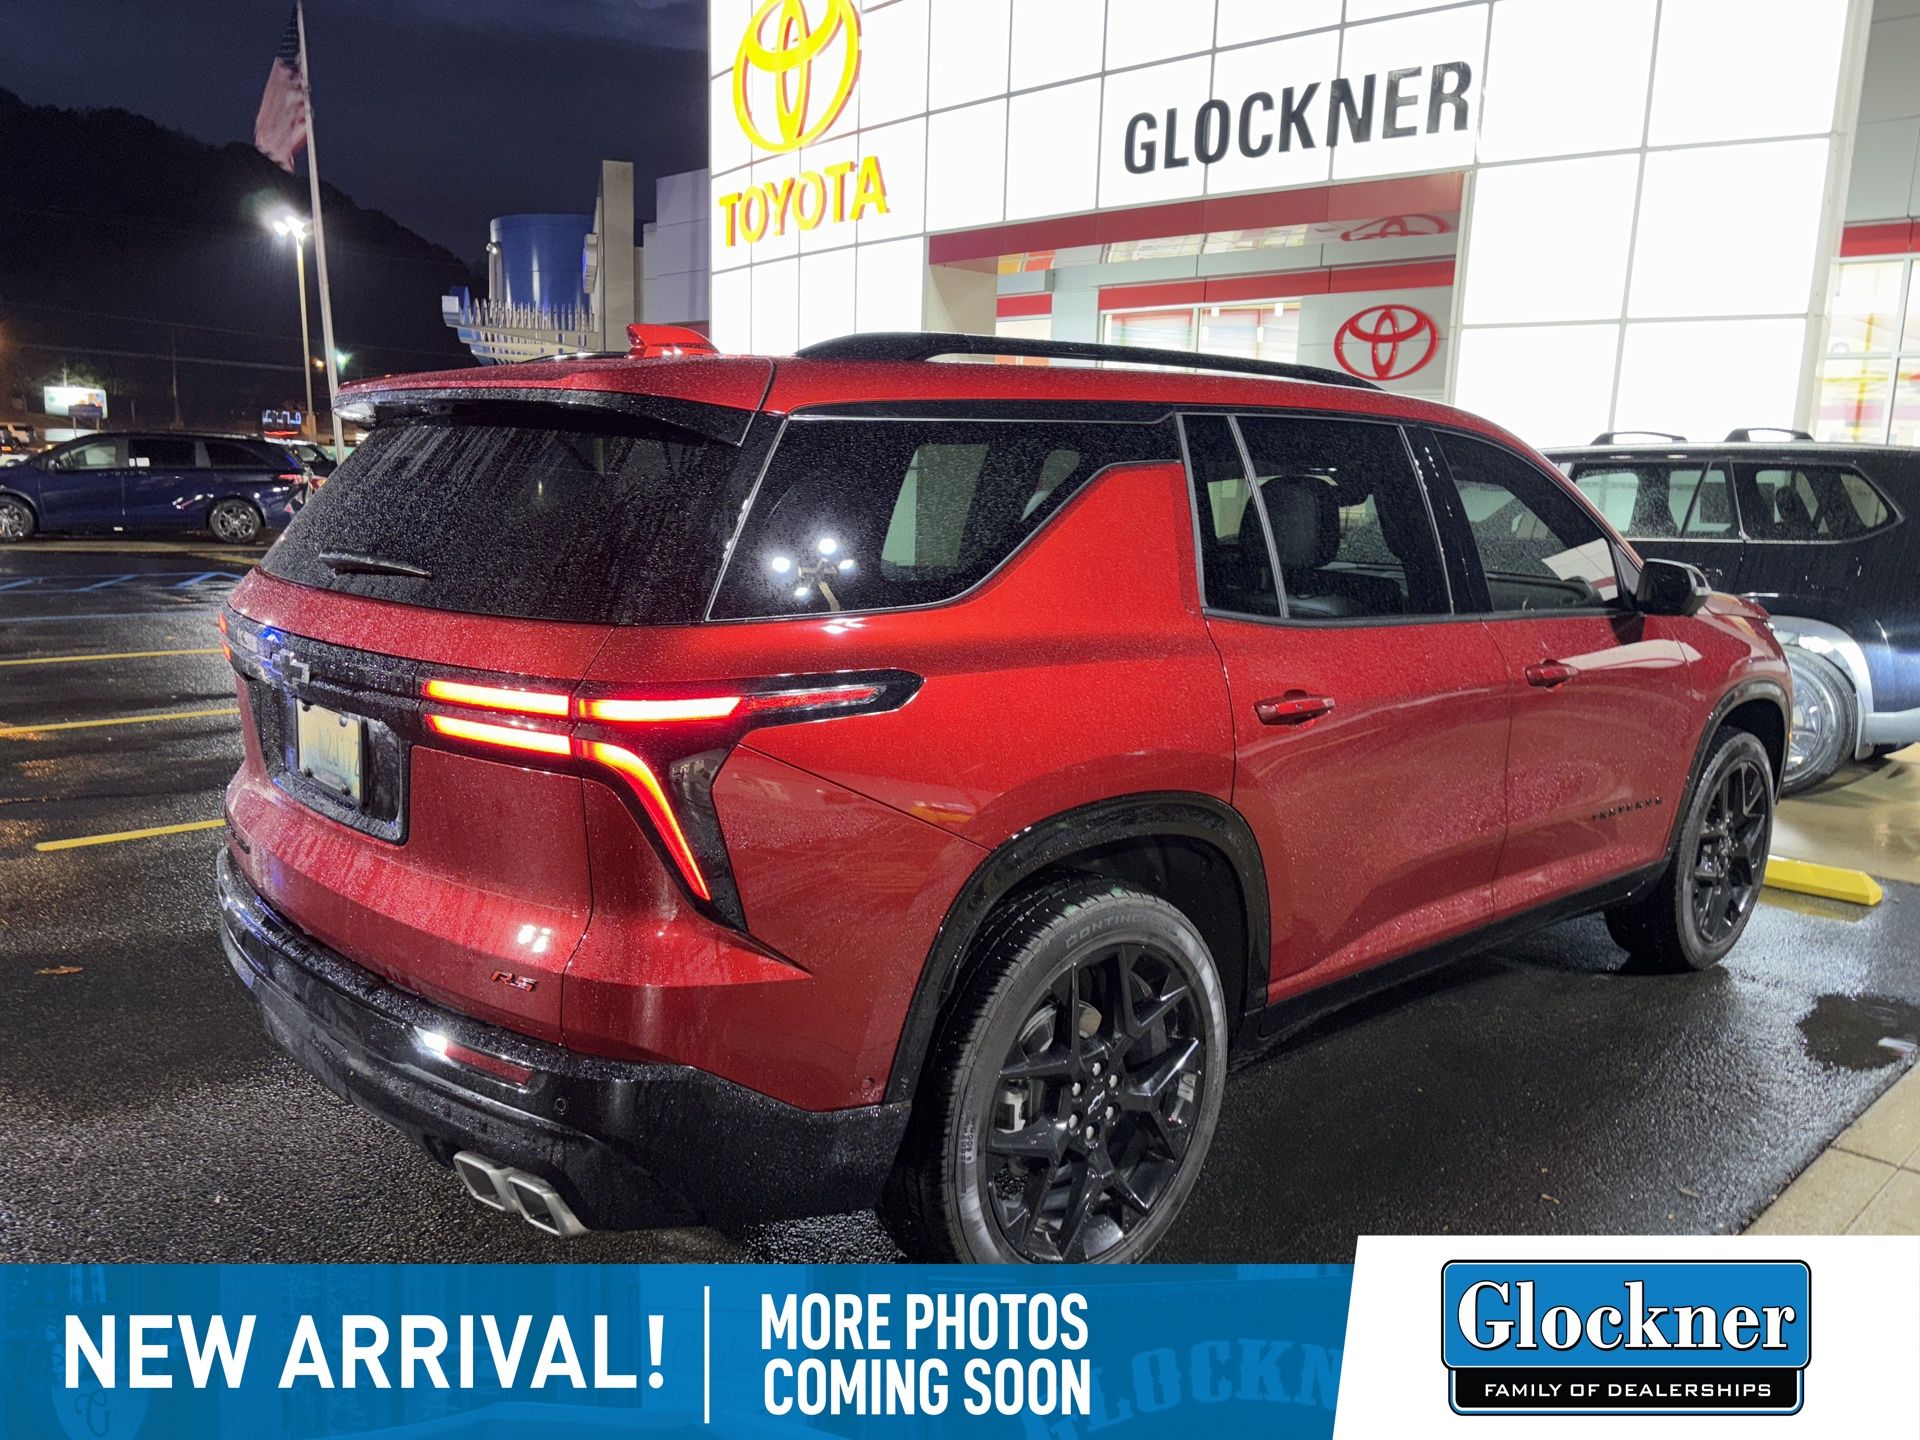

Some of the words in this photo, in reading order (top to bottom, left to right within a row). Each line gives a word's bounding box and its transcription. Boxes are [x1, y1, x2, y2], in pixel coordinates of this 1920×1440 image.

[1124, 60, 1473, 175] GLOCKNER
[718, 155, 891, 248] TOYOTA
[490, 970, 539, 993] RS
